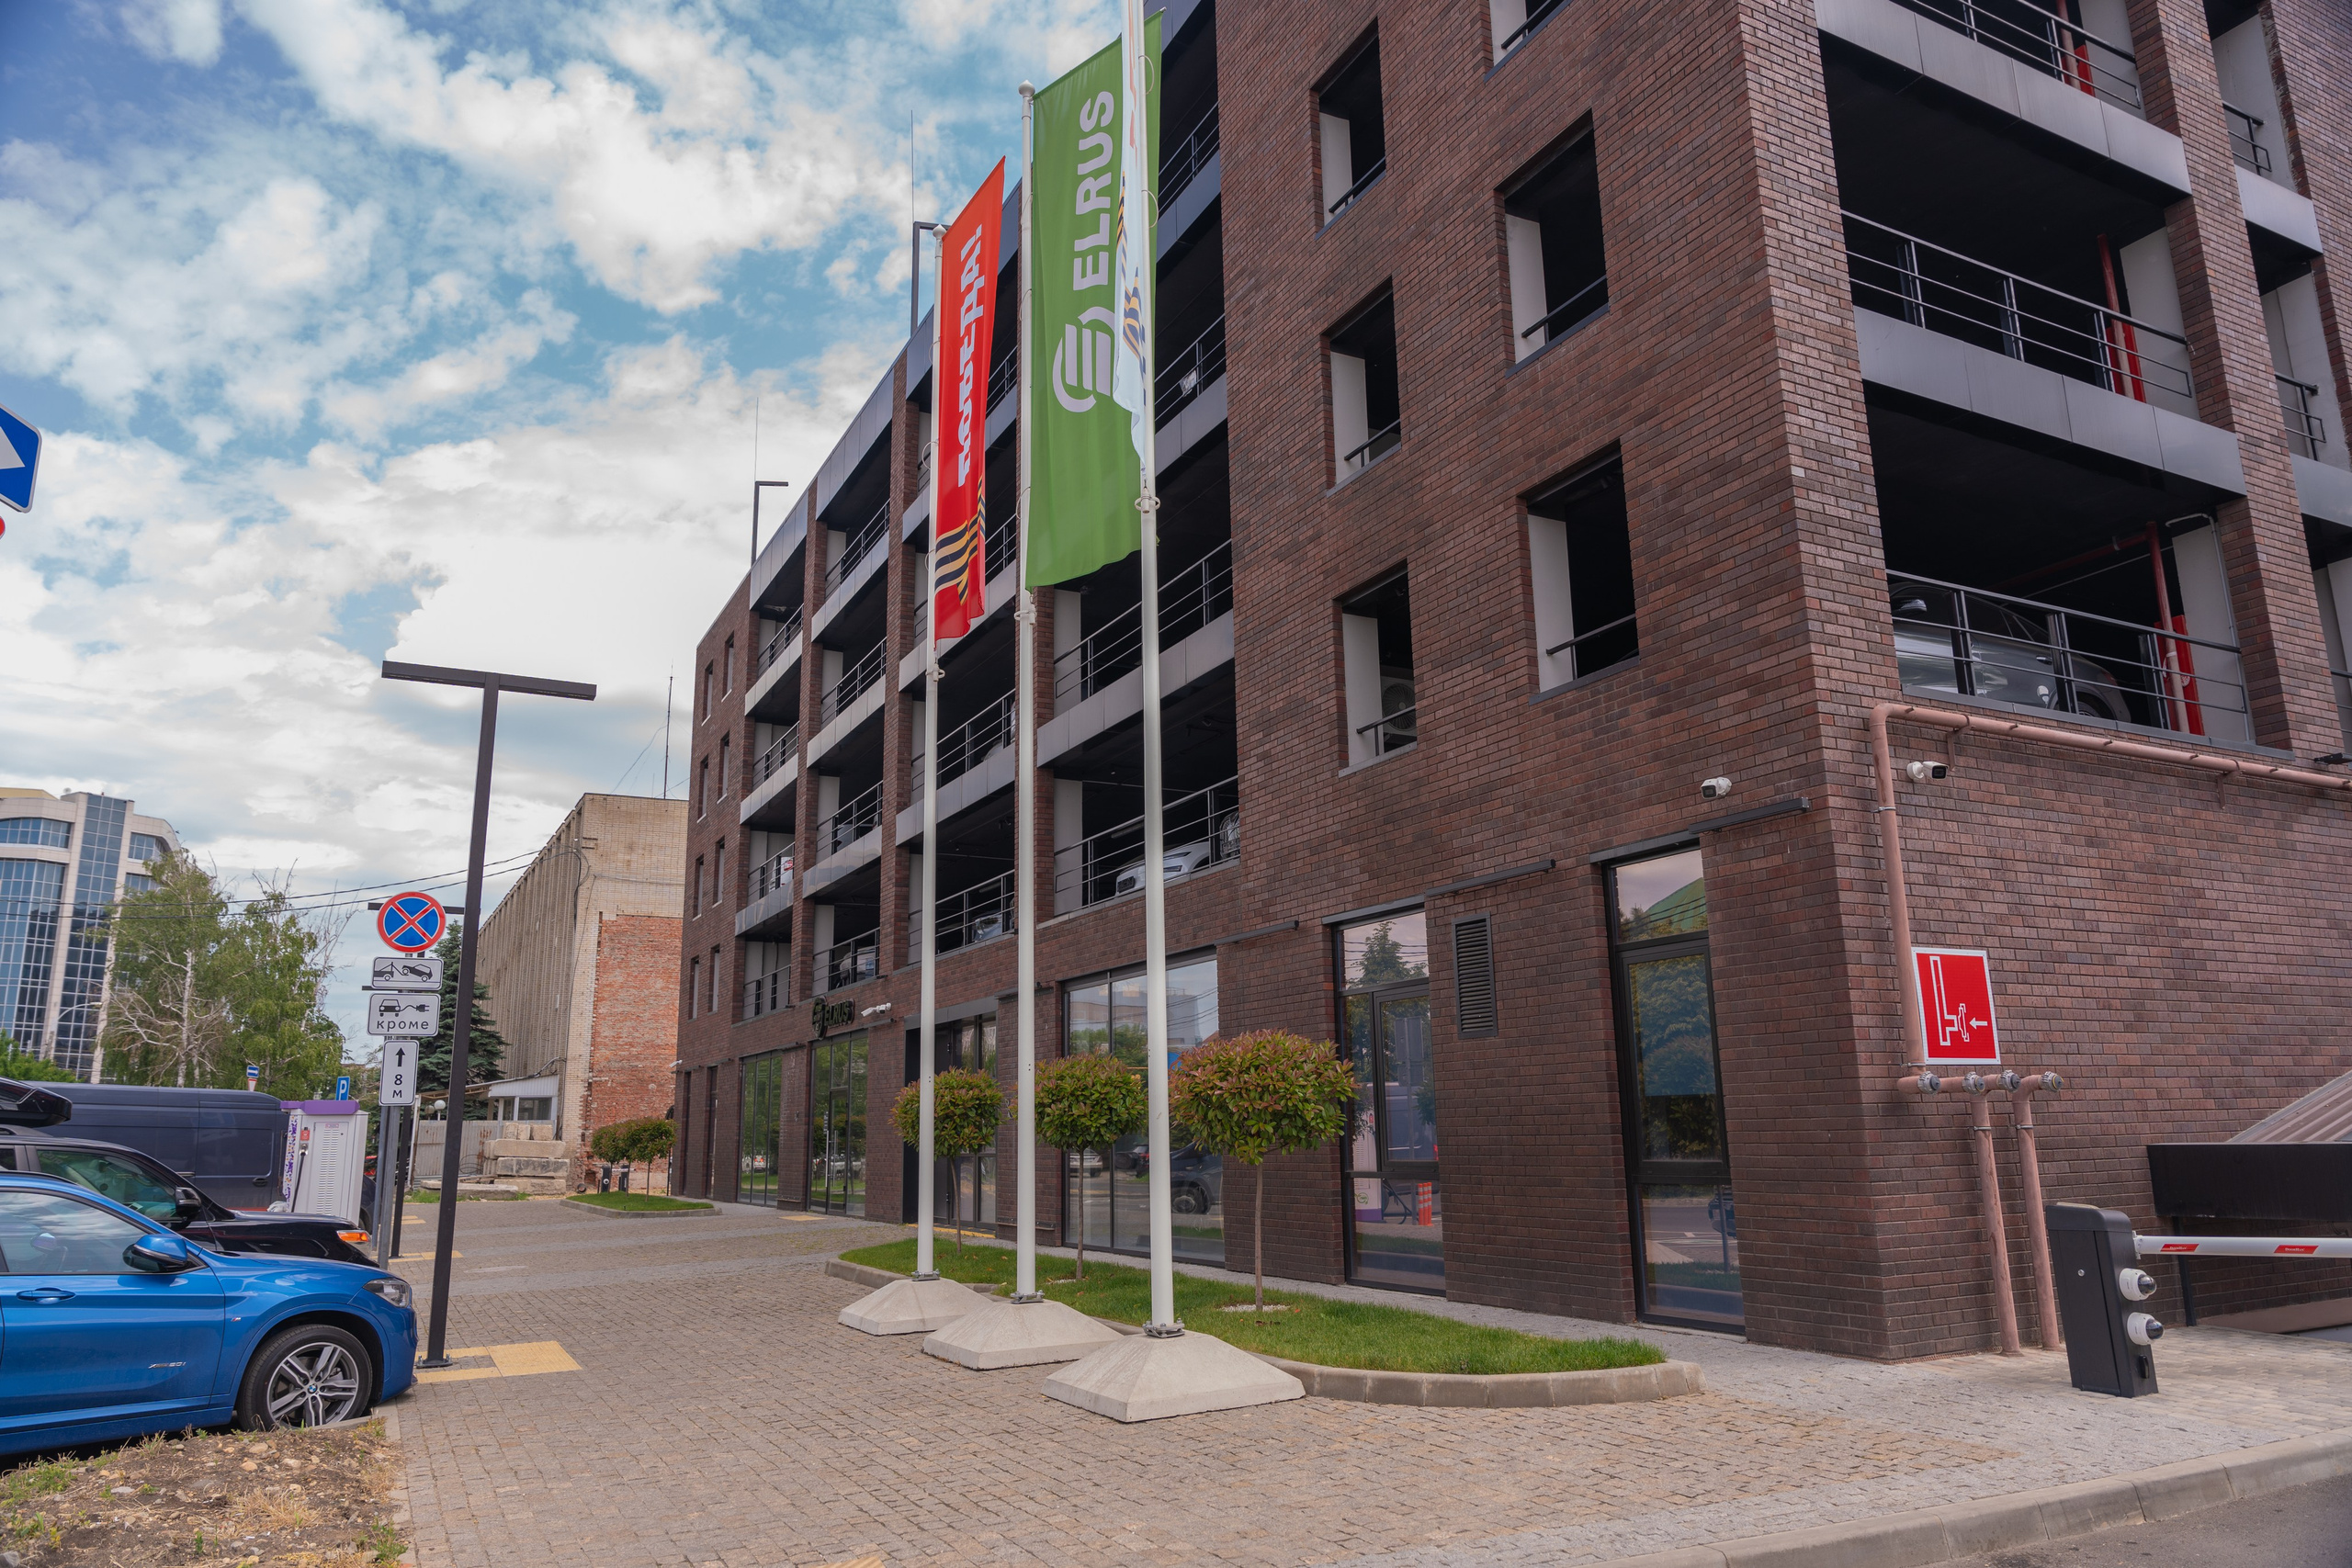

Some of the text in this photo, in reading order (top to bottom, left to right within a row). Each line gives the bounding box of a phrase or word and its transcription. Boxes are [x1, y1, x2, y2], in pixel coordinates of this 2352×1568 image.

[1072, 90, 1115, 291] ELRUS
[956, 223, 986, 488] ПОБЕДА!
[377, 1020, 429, 1032] кроме
[824, 999, 853, 1026] ELRUS
[394, 1074, 403, 1086] 8
